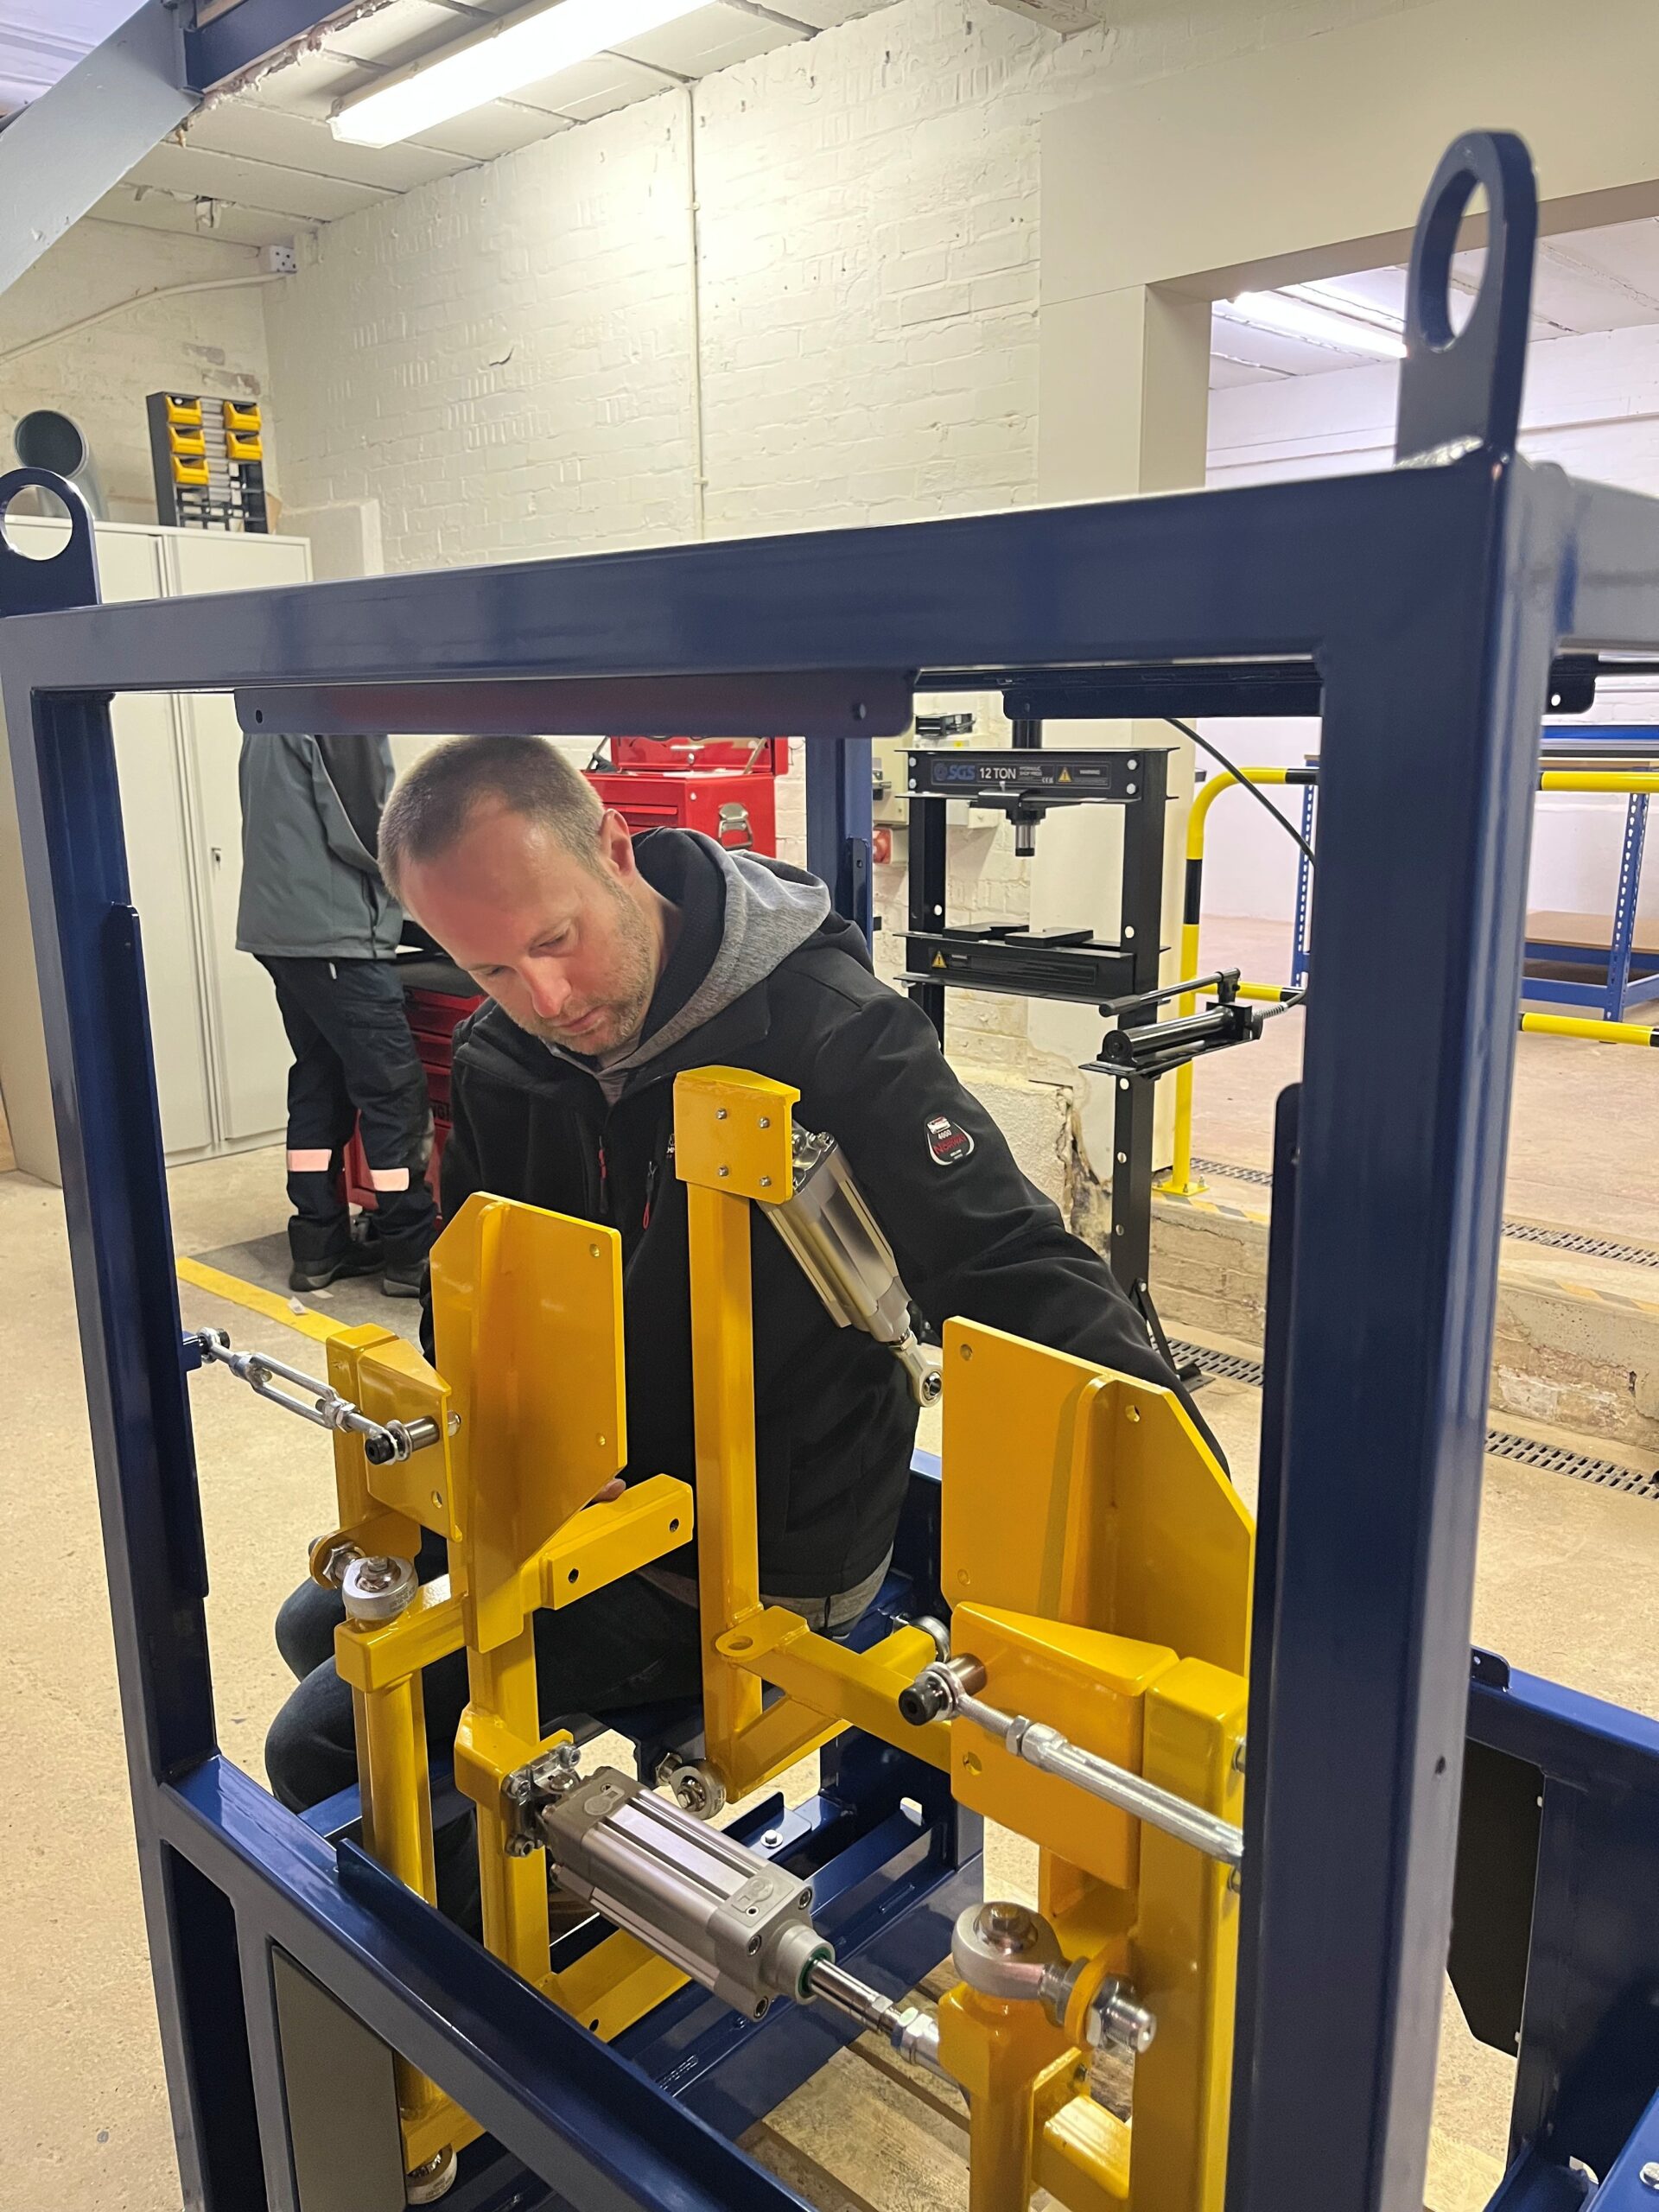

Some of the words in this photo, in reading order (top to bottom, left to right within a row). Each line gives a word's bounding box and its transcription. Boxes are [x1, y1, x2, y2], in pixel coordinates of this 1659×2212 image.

[947, 765, 975, 780] SGS
[980, 767, 992, 779] 12
[993, 767, 1016, 779] TON
